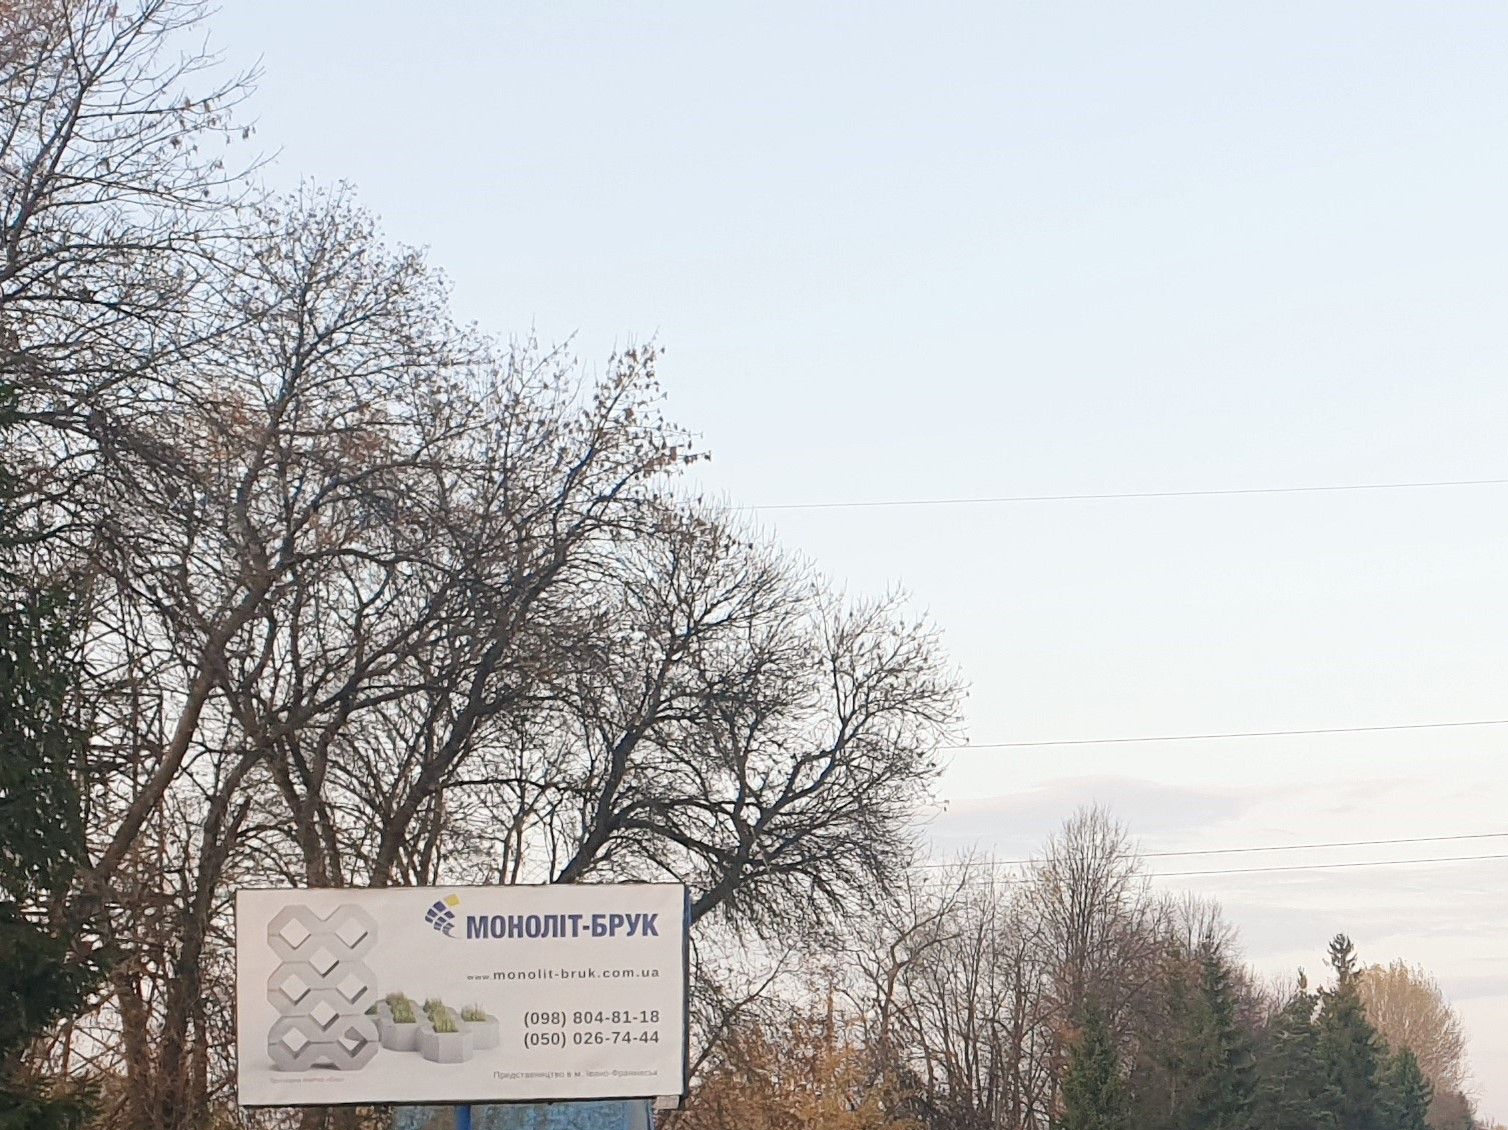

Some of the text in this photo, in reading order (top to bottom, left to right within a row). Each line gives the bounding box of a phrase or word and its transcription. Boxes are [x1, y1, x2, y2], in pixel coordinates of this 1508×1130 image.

[466, 913, 660, 940] МОНОЛІТ-БРУК
[523, 1010, 660, 1028] (098) 804-81-18
[523, 1030, 660, 1049] (050) 026-74-44
